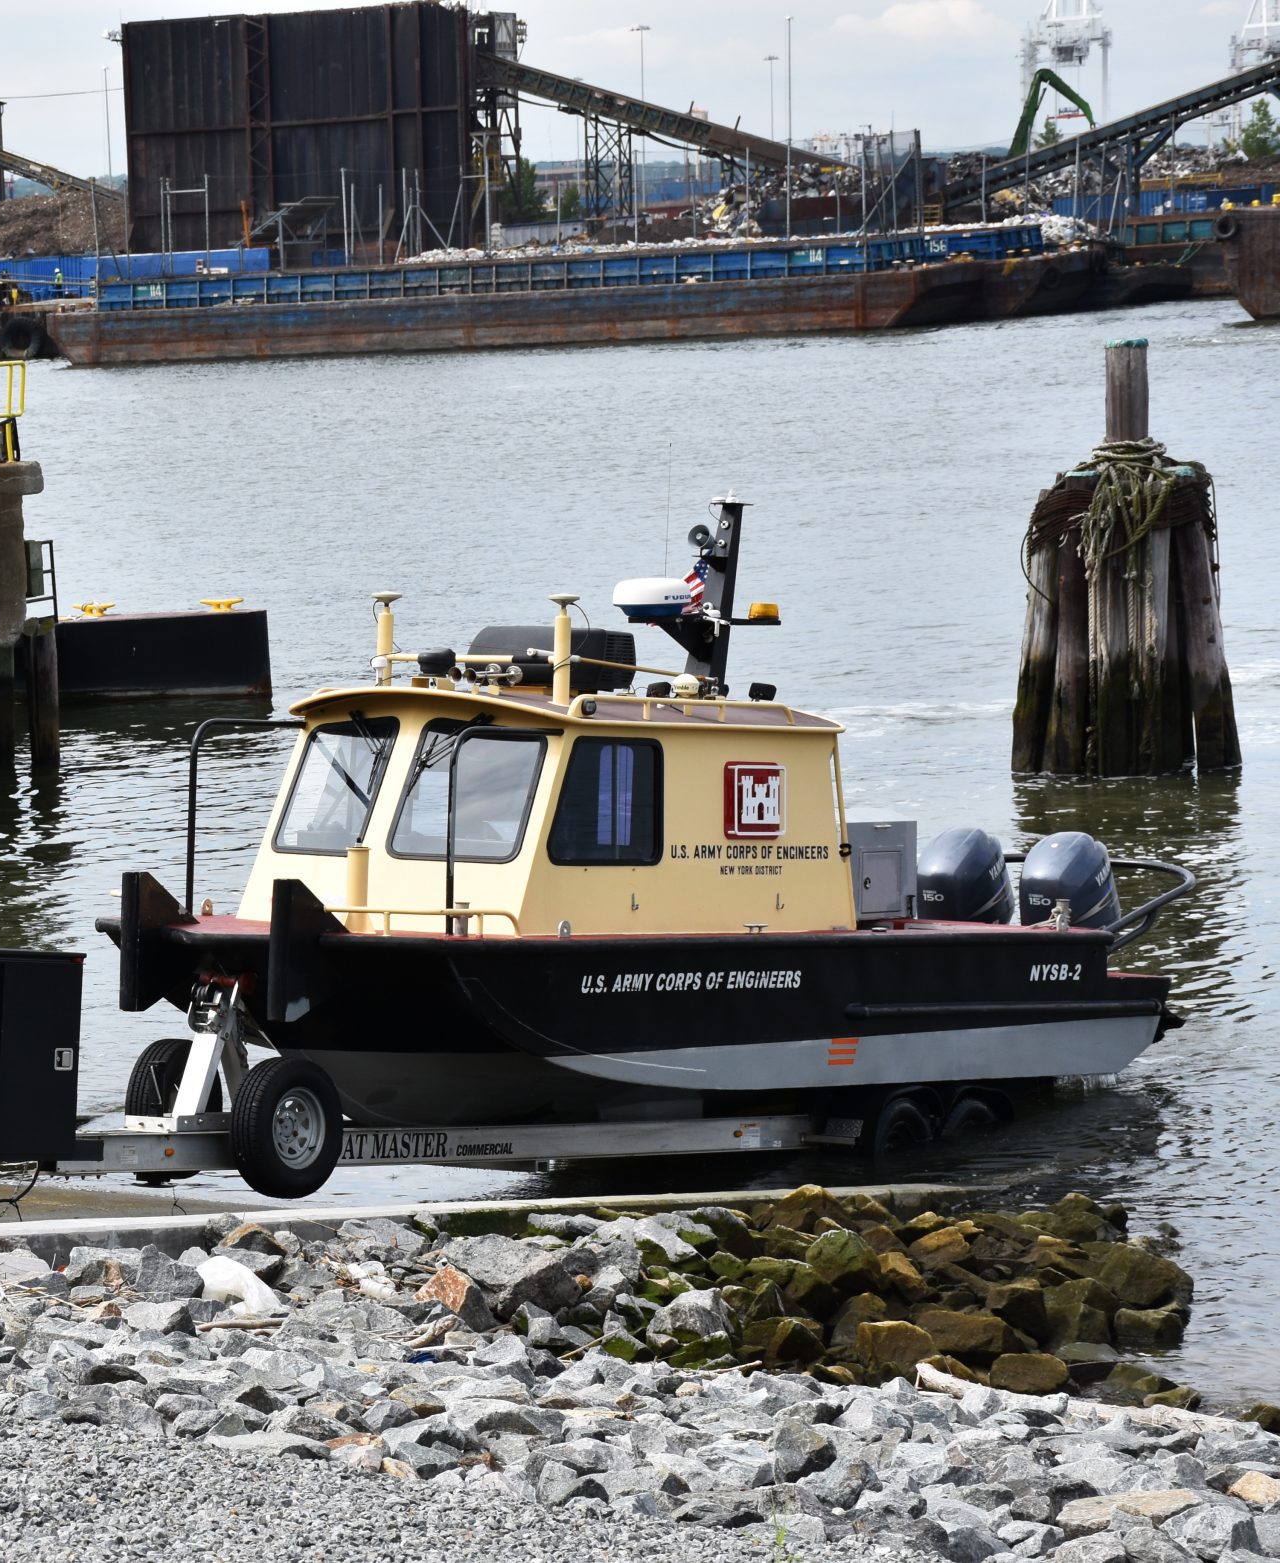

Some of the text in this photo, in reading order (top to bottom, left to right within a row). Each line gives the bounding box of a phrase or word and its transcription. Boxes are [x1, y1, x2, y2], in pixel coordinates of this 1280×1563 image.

[929, 239, 947, 253] 156
[810, 249, 822, 262] 114
[670, 844, 829, 860] U.S. ARMY CORPS OF ENGINEERS
[720, 865, 783, 876] NEW YORK DISTRICT
[922, 893, 945, 902] 150
[1028, 897, 1052, 906] 150
[1029, 963, 1082, 981] NYSB-2
[581, 970, 802, 993] U.S. ARMY CORPS OF ENGINEERS
[341, 1131, 514, 1160] AT MASTER COMMERCIAL
